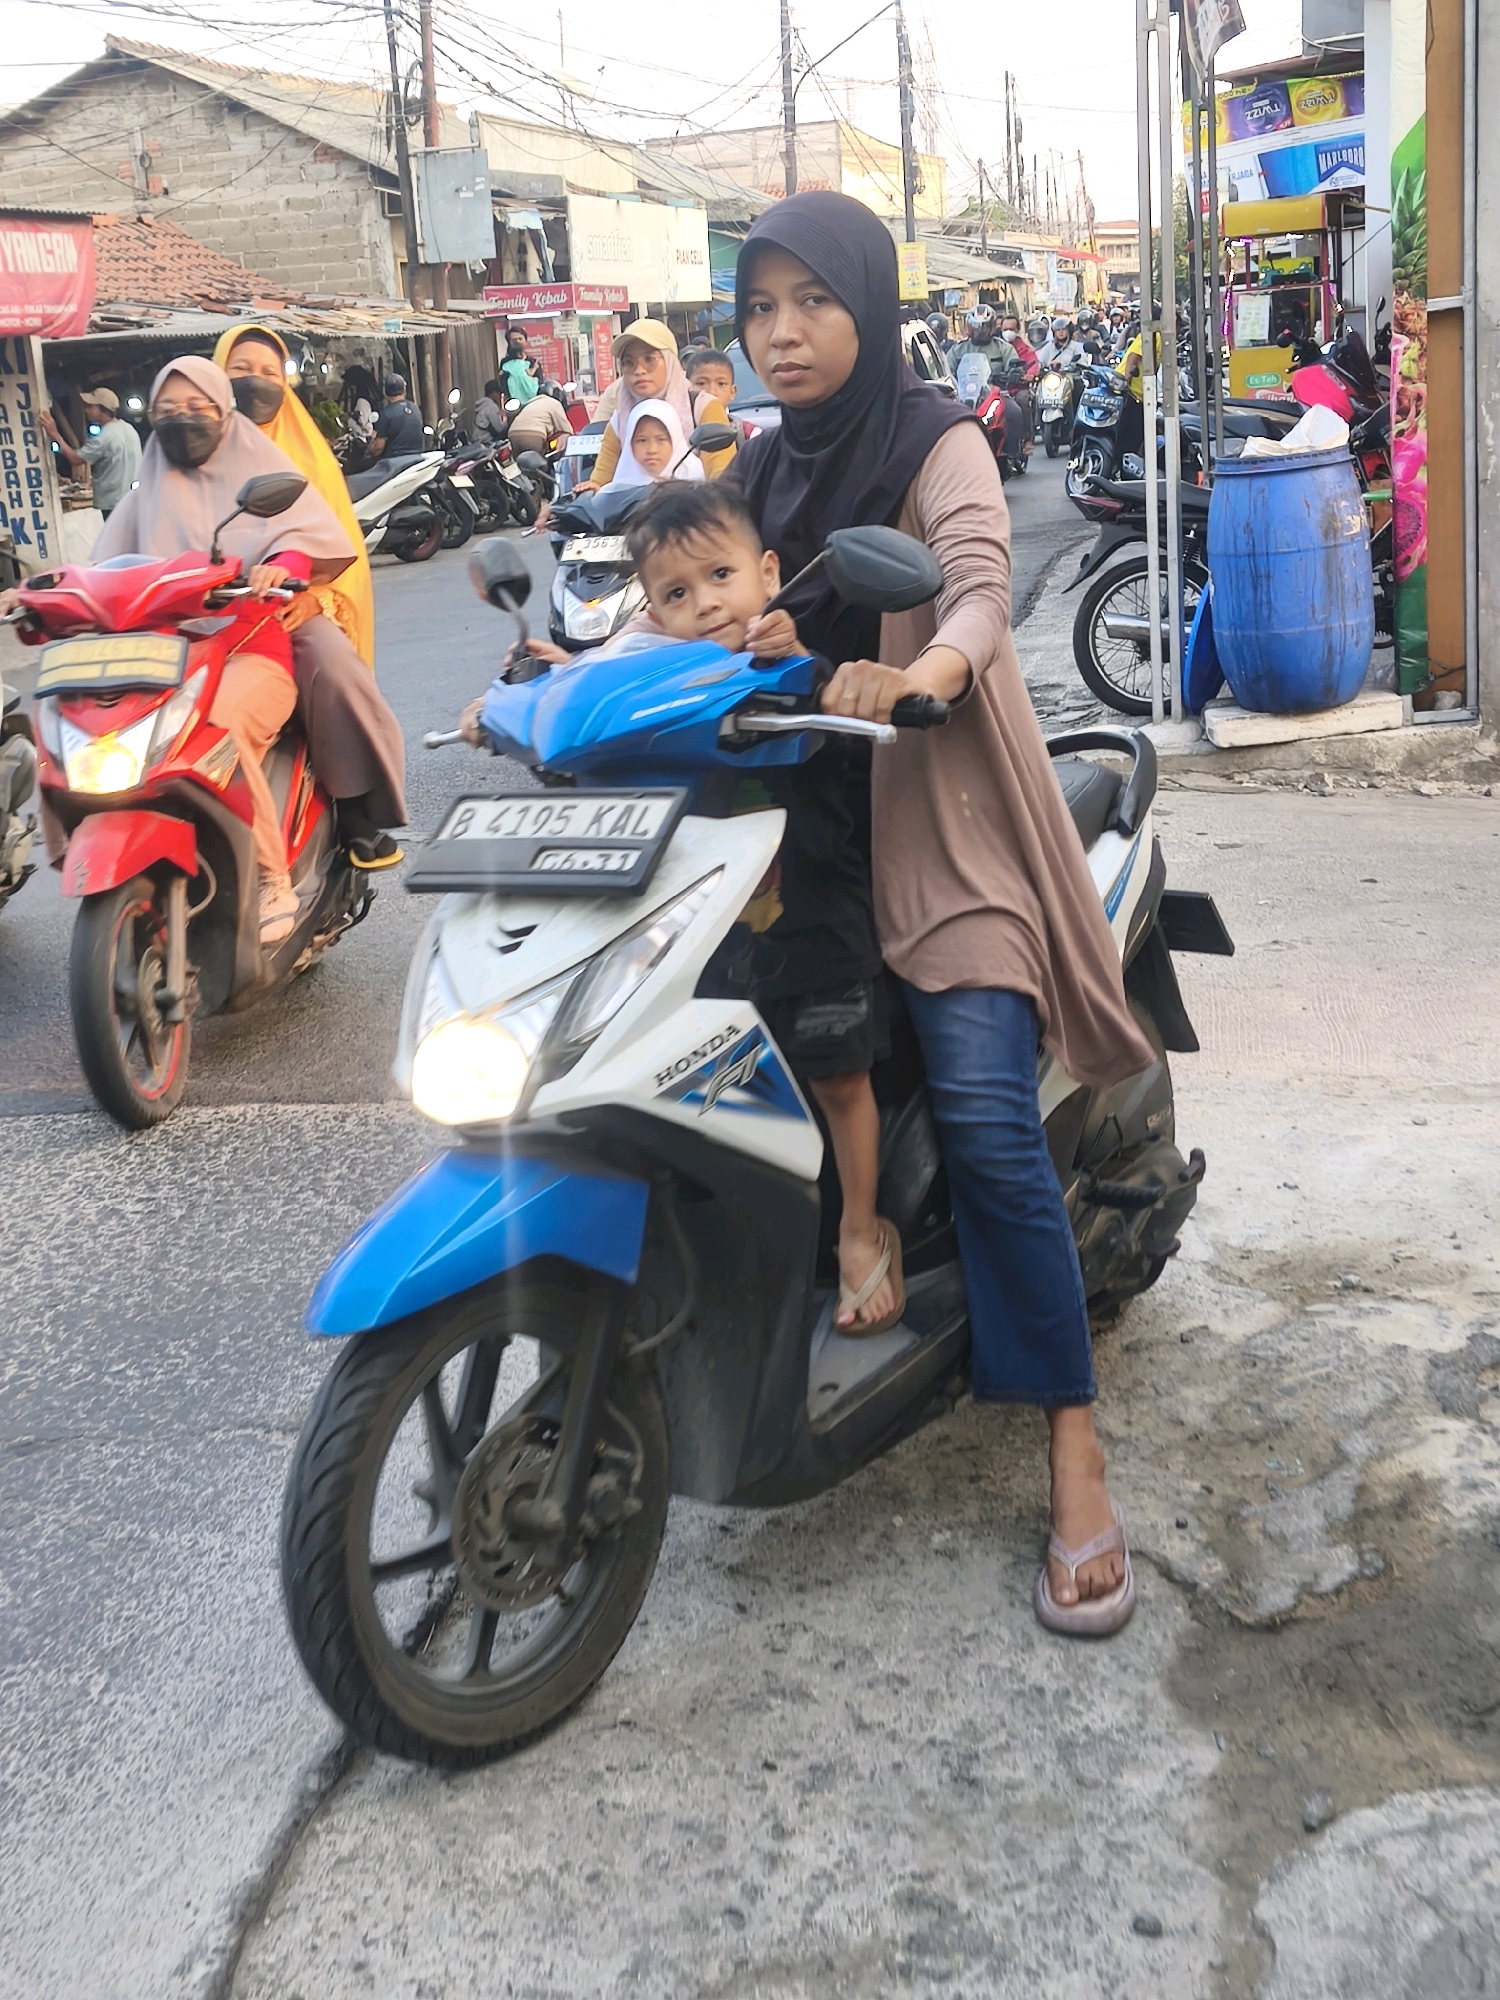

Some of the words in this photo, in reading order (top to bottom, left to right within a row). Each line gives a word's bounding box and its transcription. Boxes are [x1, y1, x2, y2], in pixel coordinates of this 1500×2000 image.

[1244, 102, 1281, 121] TWIZZ
[1298, 92, 1335, 109] TWIZZ
[1318, 146, 1364, 175] MARLBORO
[0, 230, 78, 273] YANGAN
[587, 229, 633, 262] smartfren
[533, 289, 568, 307] Kebab
[579, 287, 604, 306] Family
[603, 288, 625, 304] Kebab
[1262, 374, 1277, 384] Teh
[451, 807, 476, 840] B
[485, 804, 579, 838] 4195
[585, 804, 651, 838] KAL
[653, 1024, 742, 1088] HONDA
